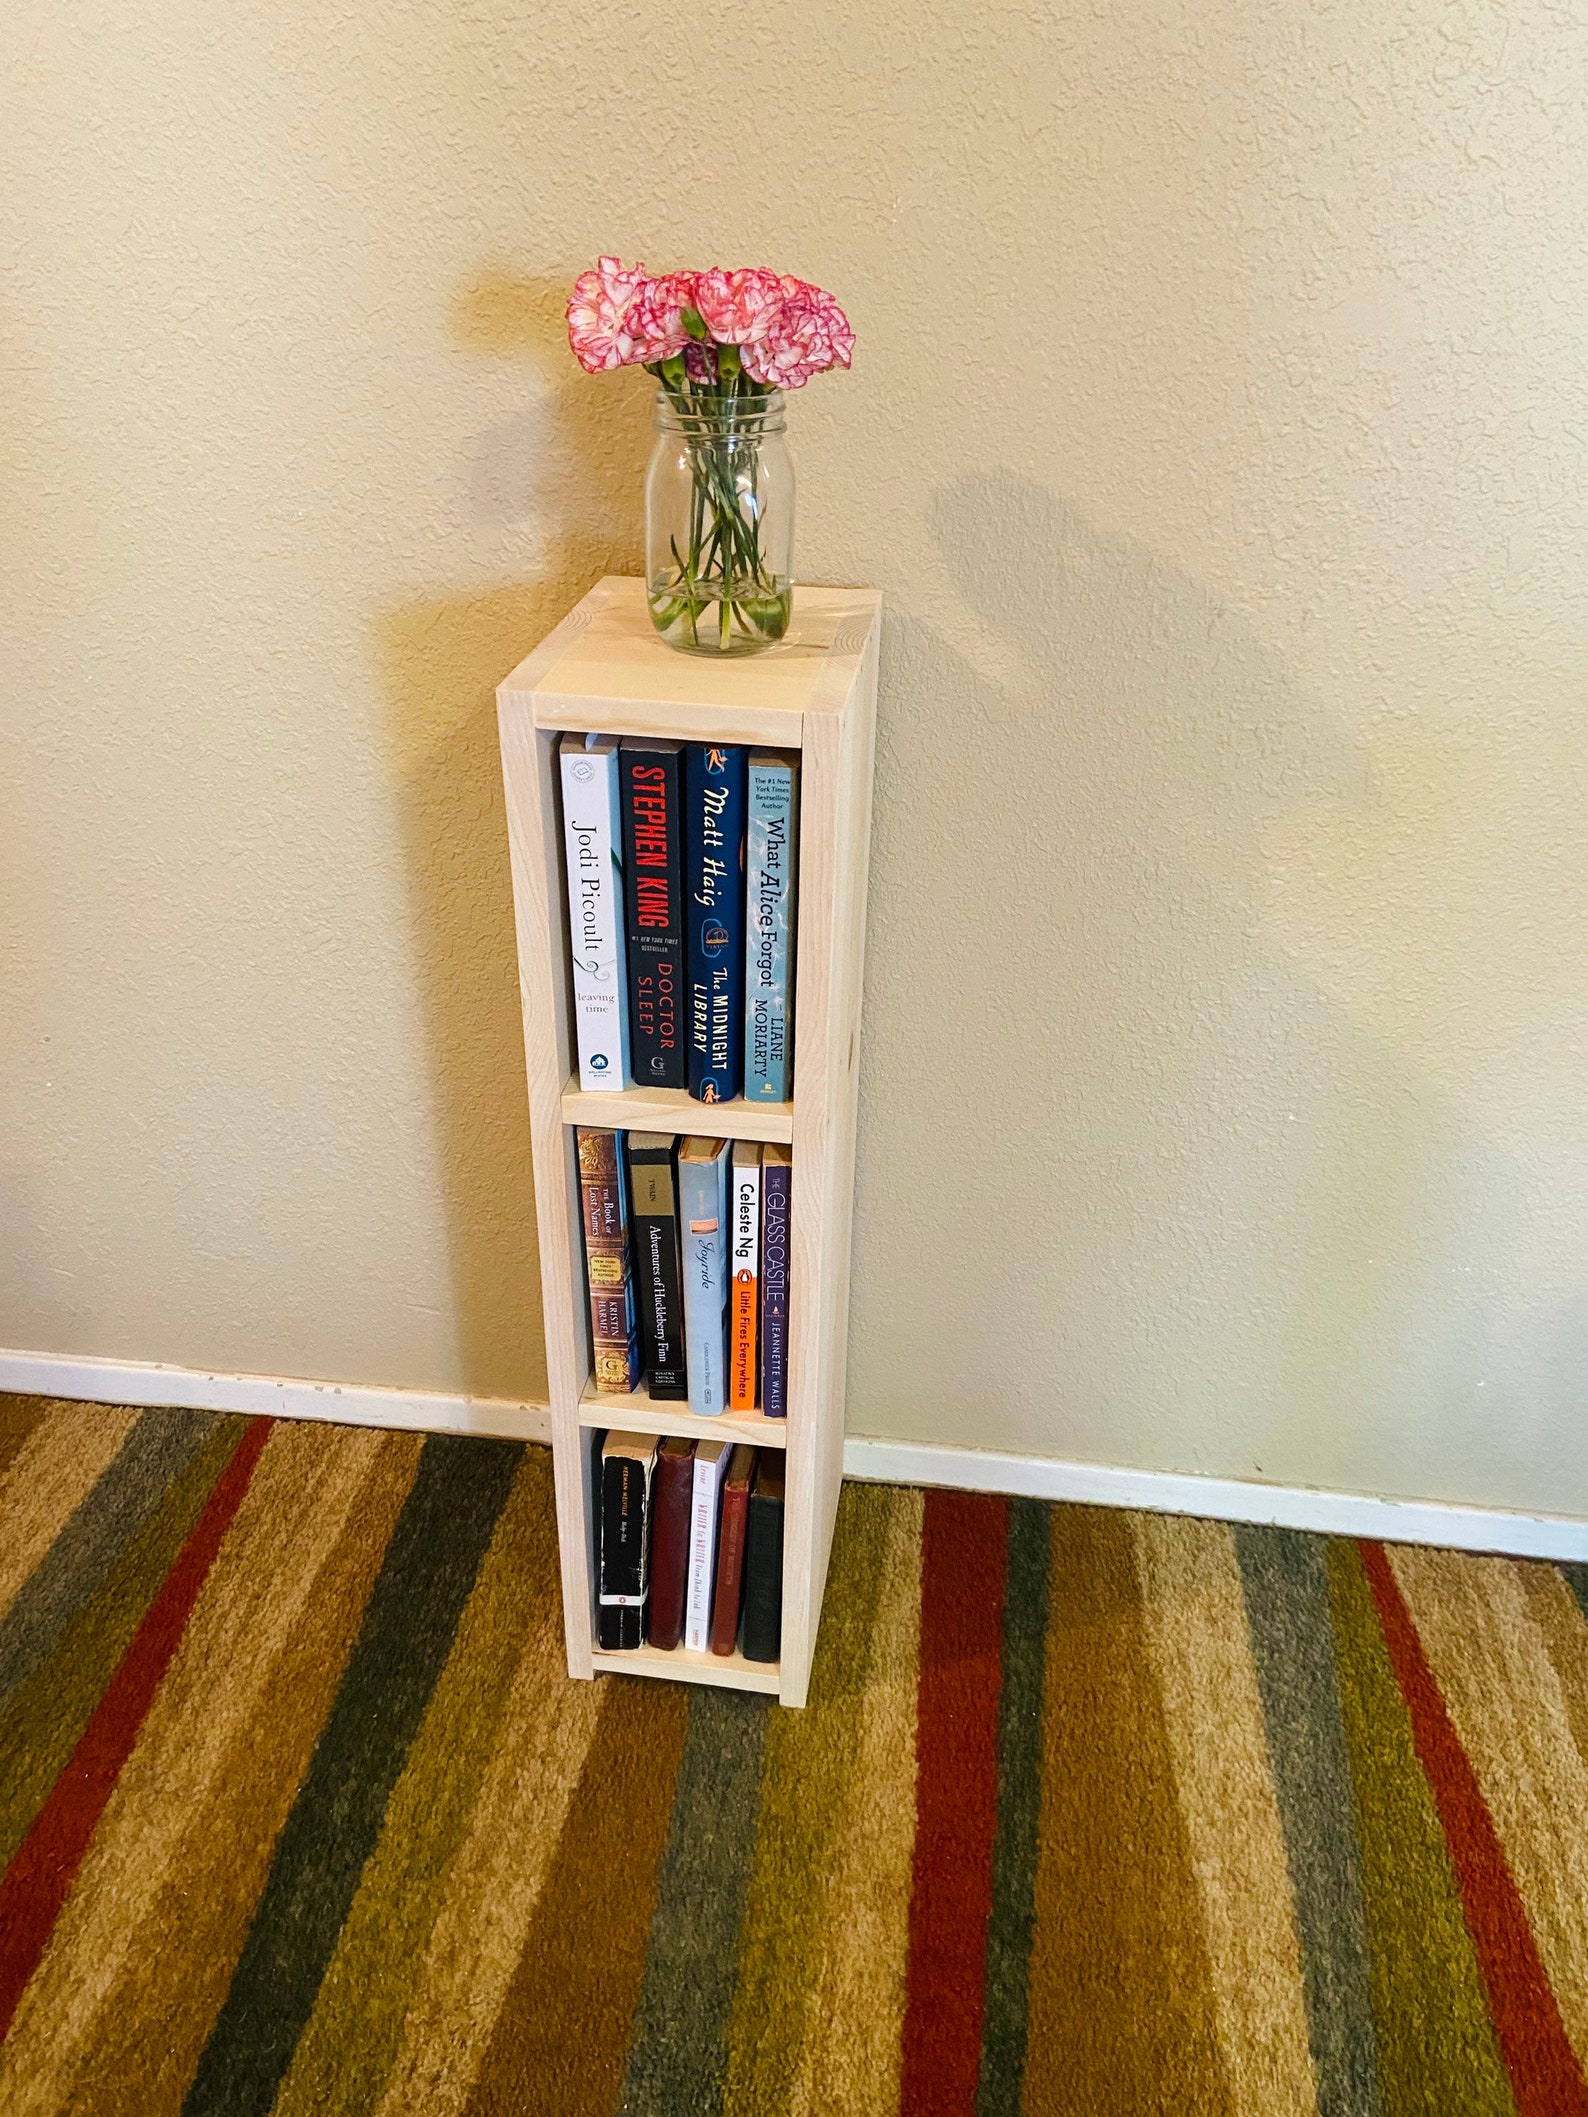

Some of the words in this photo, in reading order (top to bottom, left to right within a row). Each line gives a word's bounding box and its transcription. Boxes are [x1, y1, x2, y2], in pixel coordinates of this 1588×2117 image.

[632, 765, 668, 868] STEPHEN
[704, 787, 729, 847] Matt
[756, 794, 790, 803] Bestselling
[572, 821, 598, 868] Jodi
[768, 818, 786, 869] What
[637, 877, 669, 928] KING
[694, 857, 727, 906] Haig
[760, 871, 781, 927] Alice
[581, 878, 603, 951] Picoult
[713, 968, 728, 989] The
[757, 931, 777, 987] Forgot
[578, 992, 615, 1005] leaving
[586, 1004, 608, 1014] time
[638, 977, 654, 1035] SLEEP
[658, 964, 675, 1048] DOCTOR
[694, 984, 708, 1053] LIBRARY
[712, 995, 728, 1070] MIDNIGHT
[755, 1000, 768, 1078] MORIARTY
[770, 1018, 784, 1061] LIANE
[589, 1187, 600, 1205] Lost
[604, 1203, 615, 1224] Book
[740, 1184, 755, 1234] Celeste
[767, 1193, 785, 1244] GLASS
[591, 1208, 601, 1236] Names
[650, 1225, 661, 1275] Adventures
[695, 1239, 715, 1289] Joyride
[736, 1238, 753, 1258] Ng
[653, 1277, 665, 1289] of
[767, 1247, 785, 1301] CASTLE
[598, 1301, 608, 1336] HARMEL
[609, 1302, 619, 1336] KRISTIN
[654, 1289, 667, 1341] Huckleberry
[740, 1291, 751, 1314] Little
[658, 1343, 668, 1362] Finn
[740, 1317, 750, 1339] Fires
[772, 1322, 780, 1376] JEANNETTE
[737, 1343, 750, 1398] Everywhere
[771, 1380, 780, 1409] WALLS
